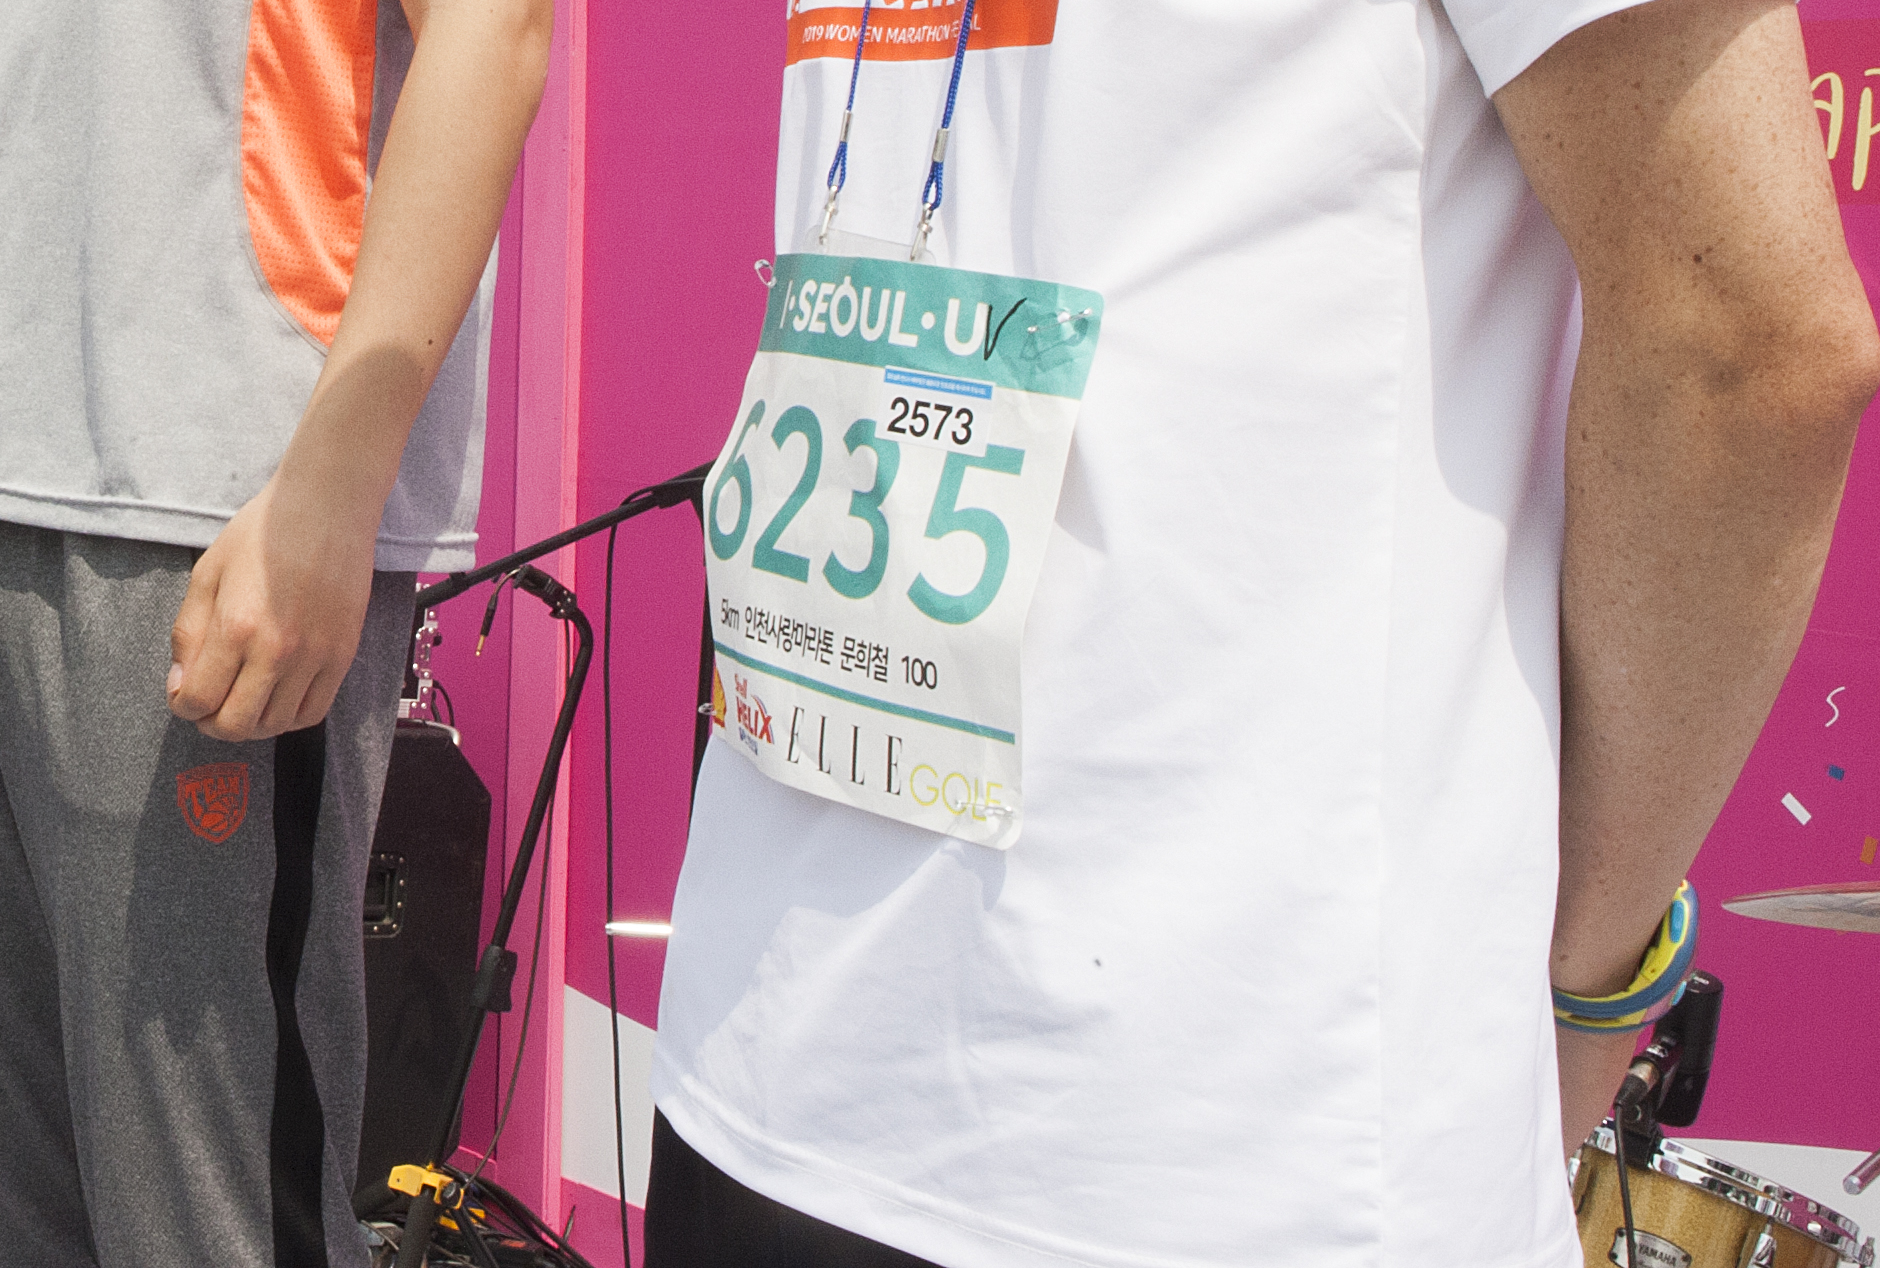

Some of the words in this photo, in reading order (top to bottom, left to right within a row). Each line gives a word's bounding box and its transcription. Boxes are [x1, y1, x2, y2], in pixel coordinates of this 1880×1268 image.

[825, 23, 882, 44] WOMEN
[886, 23, 949, 44] MARATHON
[887, 396, 973, 446] 2573
[709, 399, 1025, 625] 6235
[745, 606, 834, 665] 인천사랑마라톤
[840, 636, 889, 683] 문희철
[901, 655, 938, 690] 100
[736, 695, 774, 745] HELIX
[787, 705, 903, 796] ELLE
[910, 764, 1003, 821] GOLF
[1640, 1244, 1677, 1266] YAMAHA
